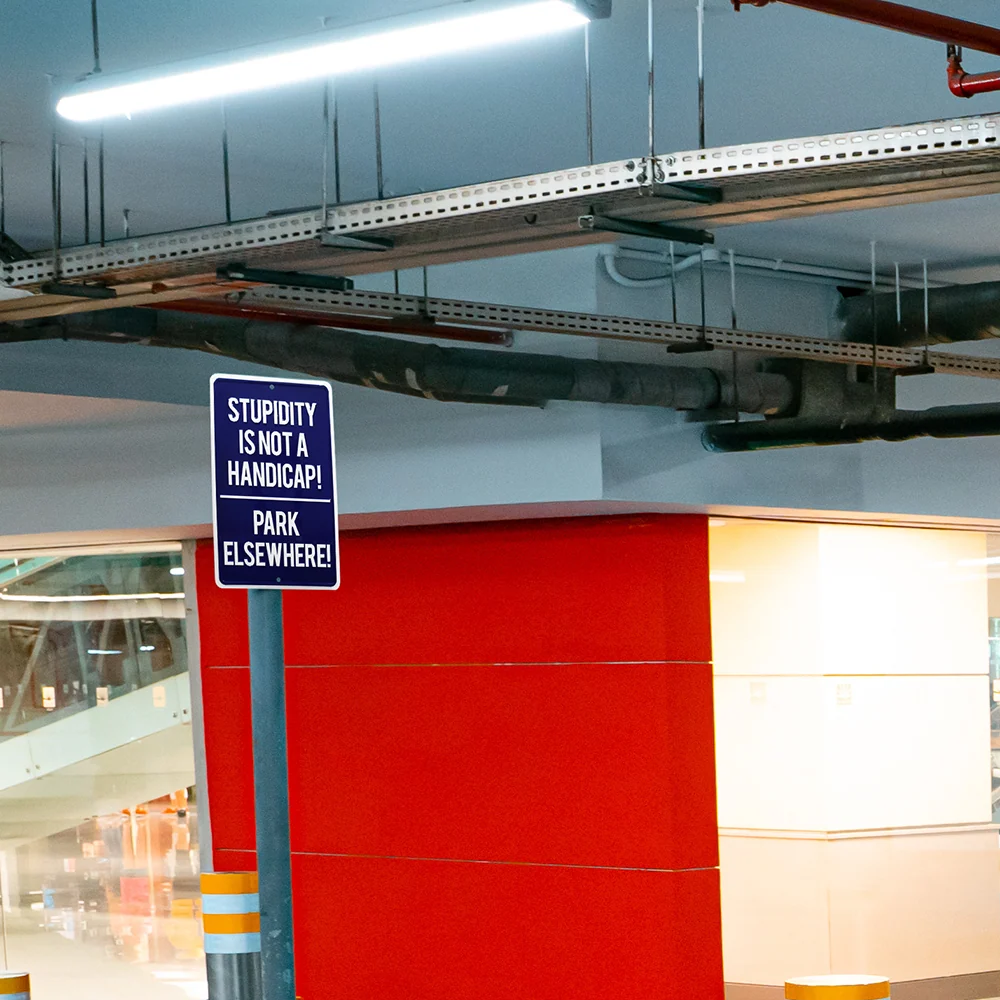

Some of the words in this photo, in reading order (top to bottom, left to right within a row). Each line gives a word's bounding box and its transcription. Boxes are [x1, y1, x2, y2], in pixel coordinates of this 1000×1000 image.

[228, 397, 316, 426] STUPIDITY
[239, 430, 255, 454] IS
[259, 431, 292, 456] NOT
[297, 433, 309, 457] A
[228, 461, 322, 489] HANDICAP!
[254, 510, 299, 536] PARK
[224, 541, 331, 567] ELSEWHERE!
